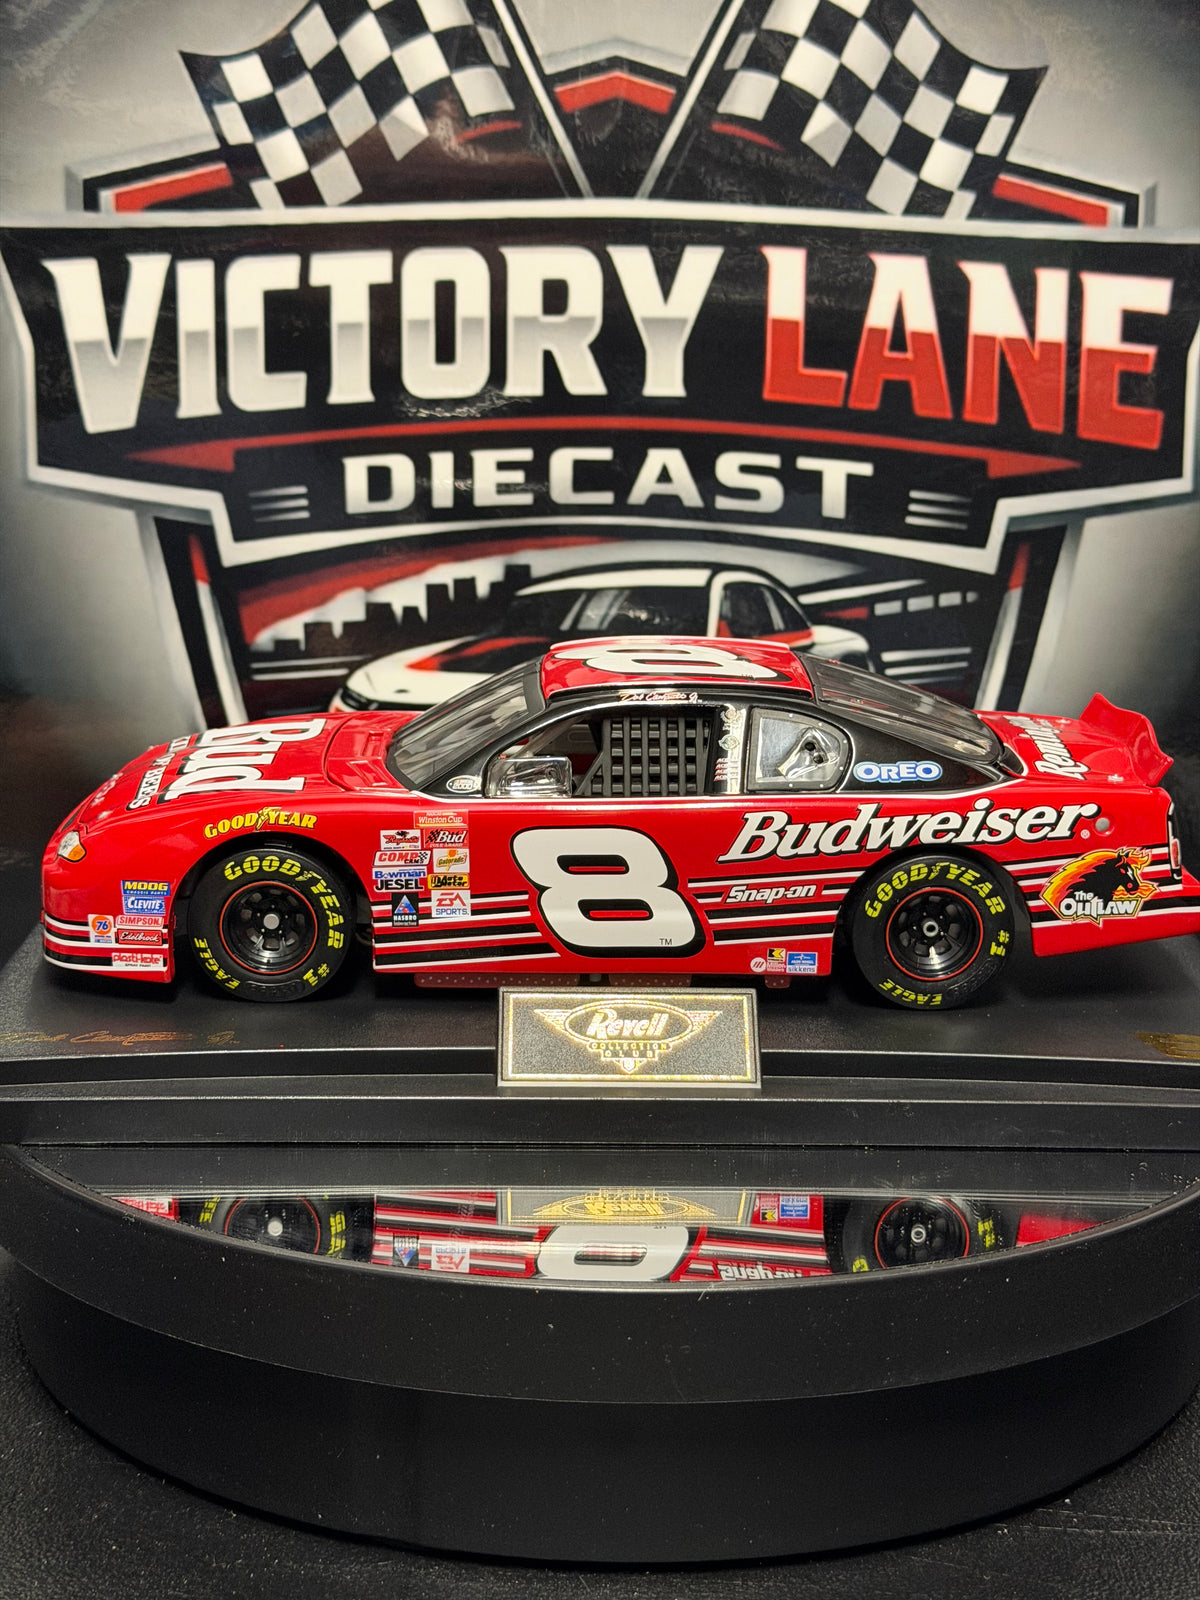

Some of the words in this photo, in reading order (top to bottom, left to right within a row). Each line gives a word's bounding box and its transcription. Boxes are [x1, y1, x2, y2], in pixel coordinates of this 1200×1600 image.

[40, 244, 725, 434] VICTORY
[760, 244, 1174, 452] LANE
[341, 445, 876, 519] DIECAST
[160, 717, 328, 803] Bud
[856, 762, 940, 780] OREO
[203, 806, 318, 839] GOODYEAR
[418, 816, 447, 824] Winston
[447, 815, 463, 824] Cup
[433, 830, 468, 844] Bud
[716, 797, 1101, 864] Budweiser
[378, 852, 419, 863] COMP
[374, 870, 426, 879] Bowman
[123, 881, 169, 891] MOOG
[375, 878, 424, 891] JESEL
[509, 824, 707, 959] 8
[864, 861, 1007, 919] GOODYEAR
[436, 892, 467, 907] EA
[724, 884, 817, 905] Snap-on
[1073, 891, 1094, 901] The
[223, 855, 345, 950] GOODYEAR
[95, 920, 110, 931] 76
[119, 916, 161, 926] SIMPSON
[119, 931, 160, 943] Edelbrock
[659, 938, 673, 946] TM
[586, 1008, 669, 1040] Revell
